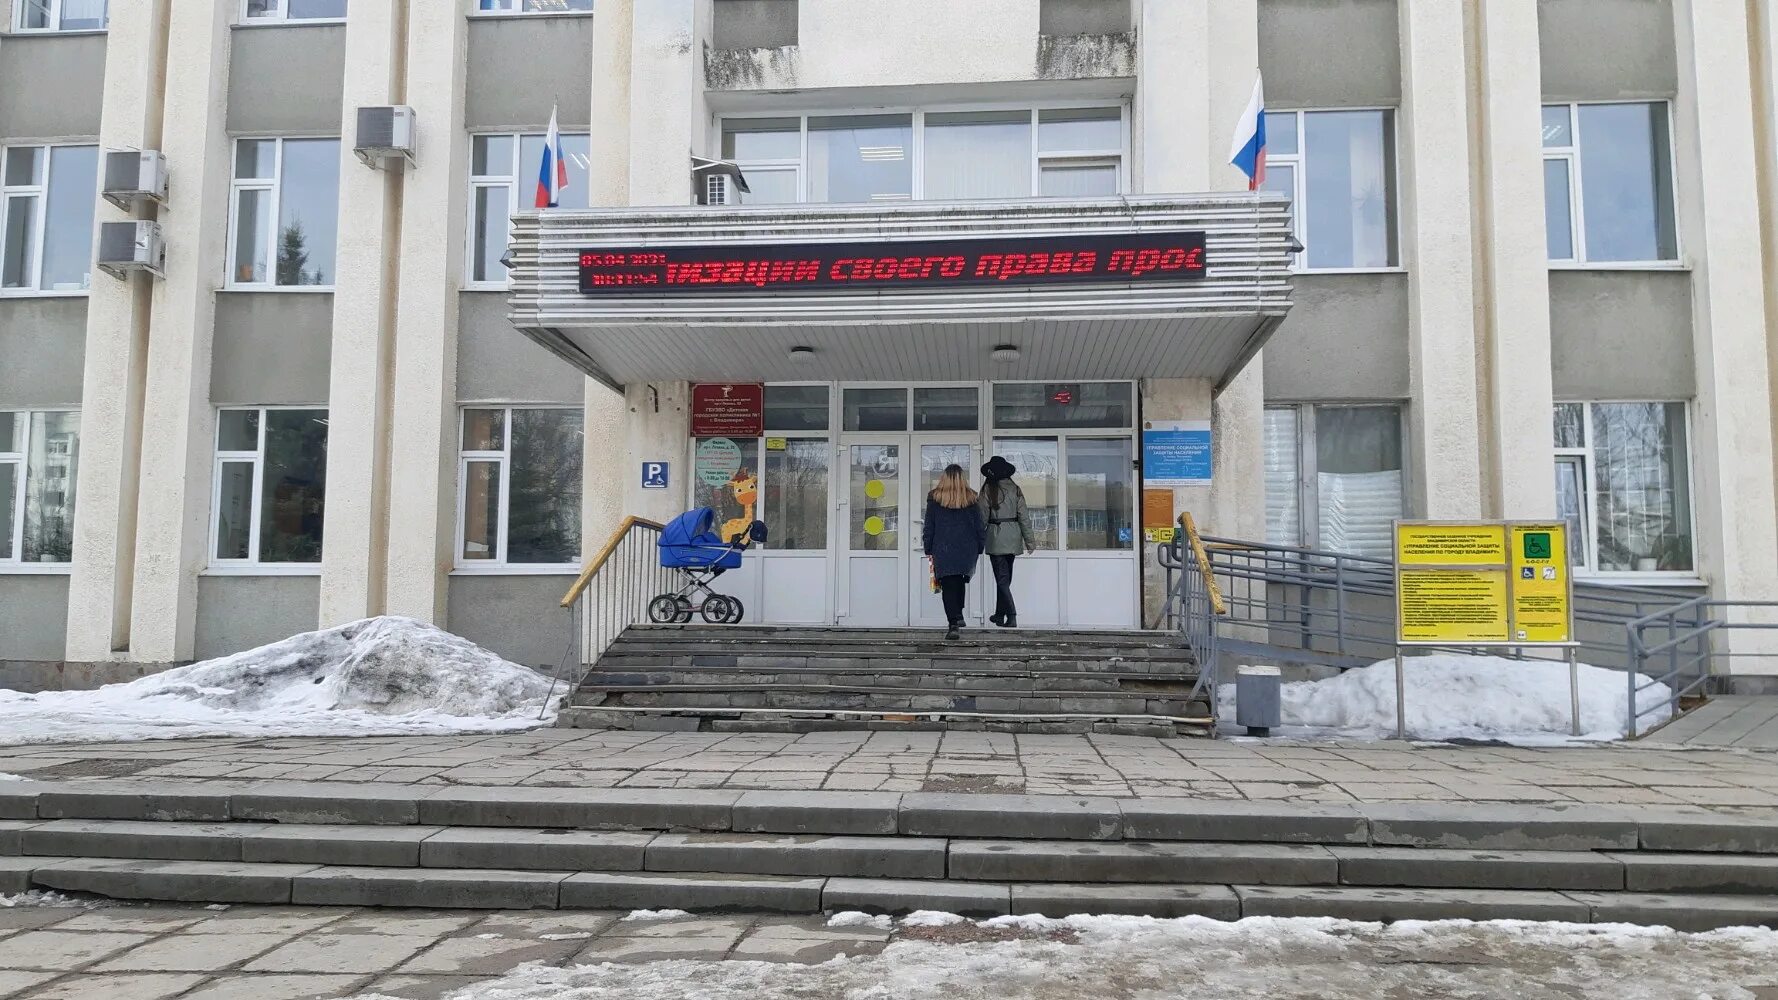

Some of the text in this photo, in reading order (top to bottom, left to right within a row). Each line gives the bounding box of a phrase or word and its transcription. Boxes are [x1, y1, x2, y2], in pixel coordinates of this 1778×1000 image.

[830, 256, 966, 280] своего
[975, 252, 1097, 279] права
[648, 464, 662, 480] P
